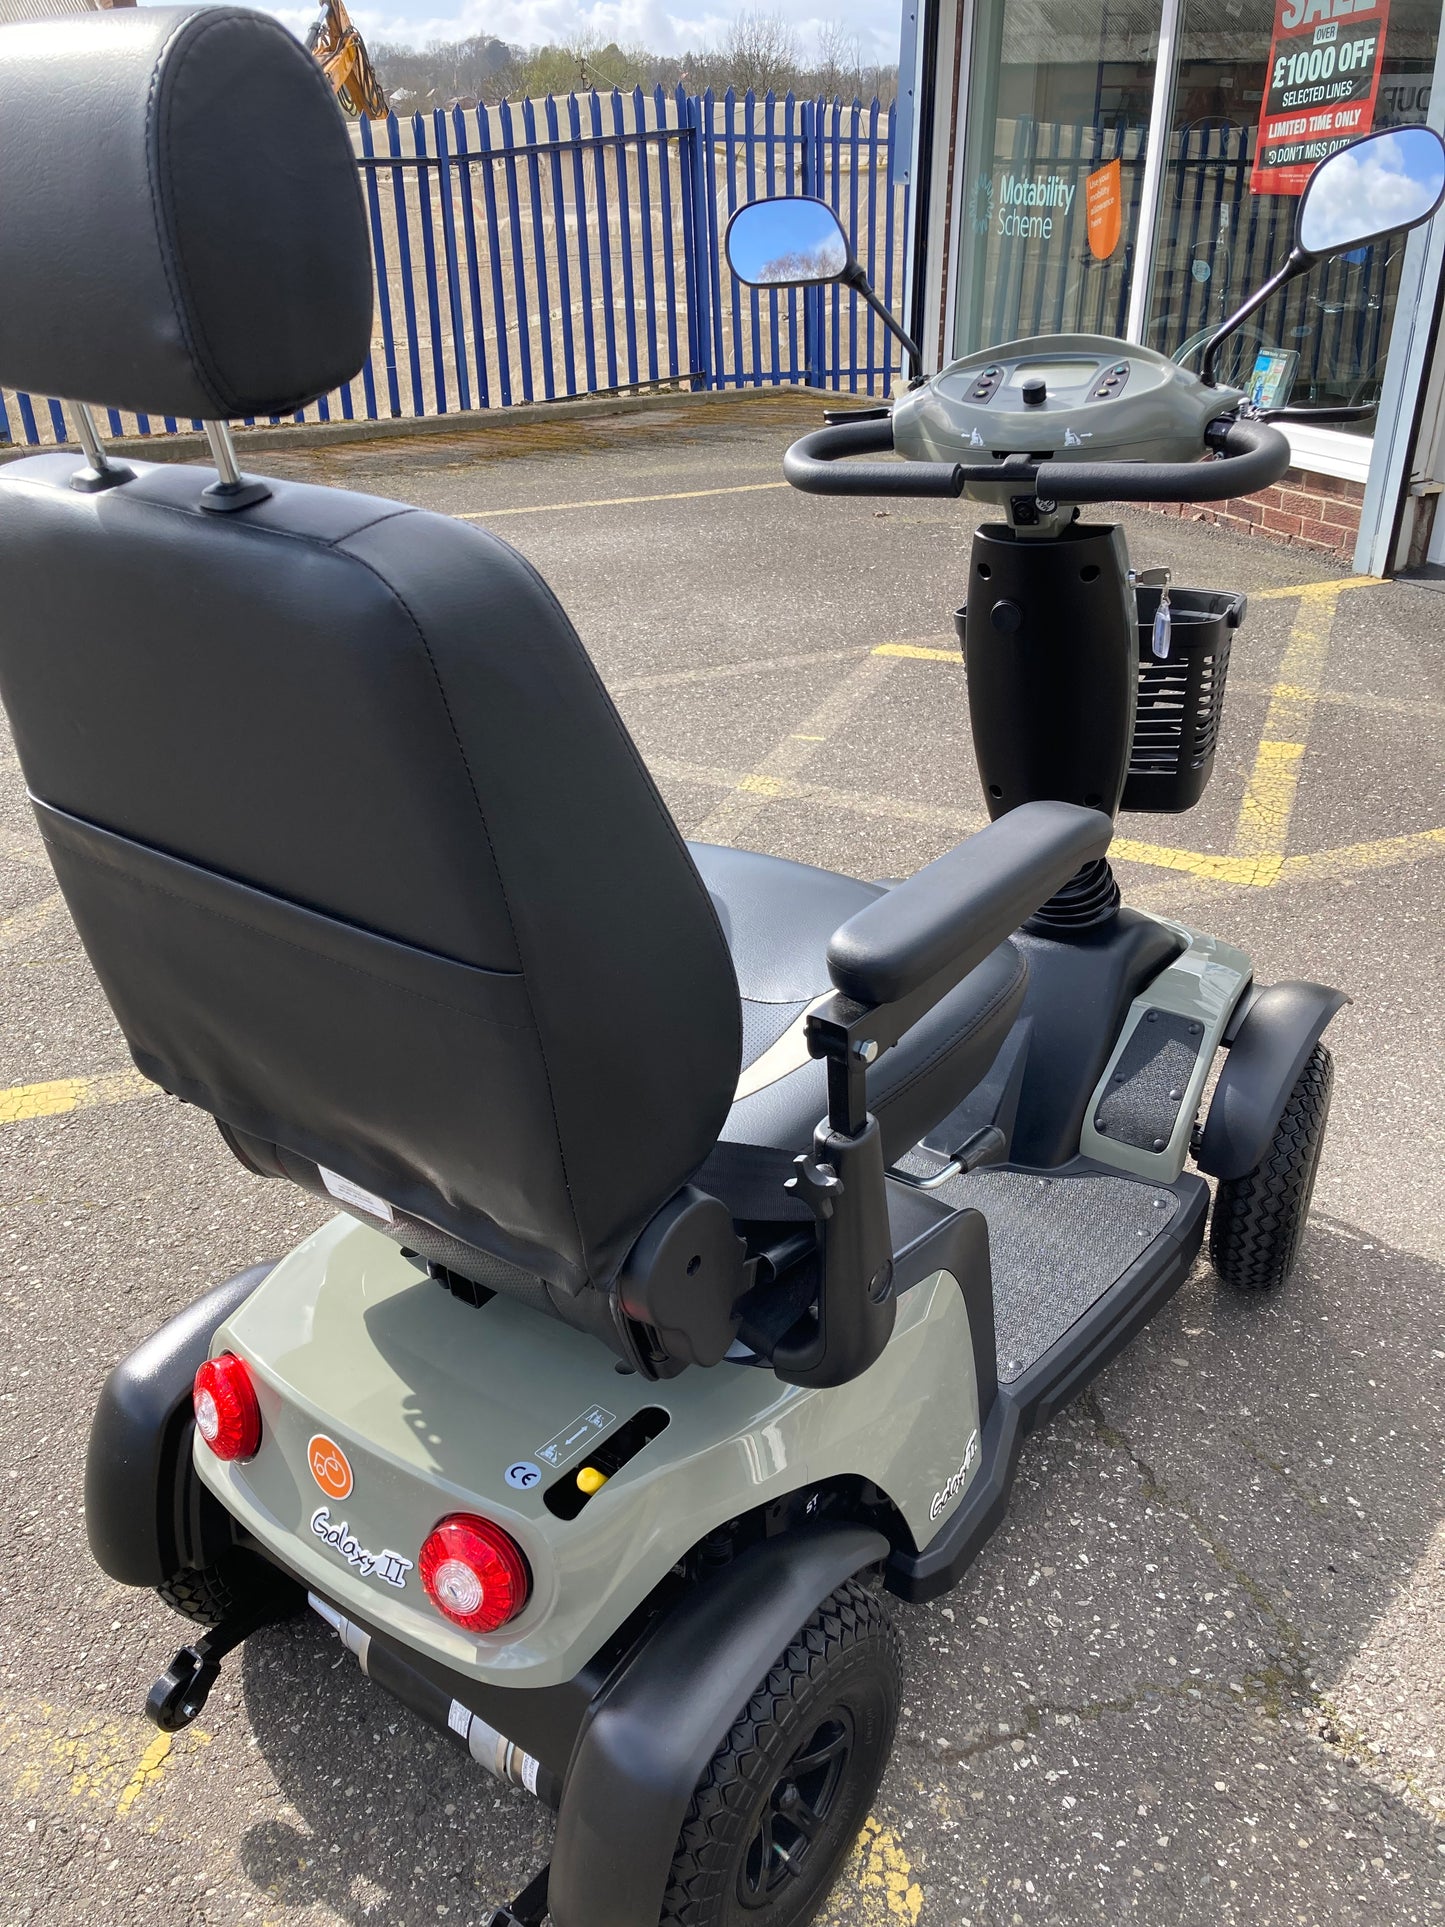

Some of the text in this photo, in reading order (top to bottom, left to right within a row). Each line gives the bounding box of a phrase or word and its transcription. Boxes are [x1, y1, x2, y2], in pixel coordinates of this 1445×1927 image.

[1281, 0, 1377, 29] SA
[1316, 26, 1337, 41] OVER
[1272, 38, 1376, 88] £1000 OFF
[1282, 80, 1353, 107] SELECTED LINES
[1268, 109, 1362, 138] LIMITED TIME ONLY
[1277, 145, 1305, 163] DON'T
[1305, 143, 1328, 159] MISS
[1000, 175, 1075, 215] Motability
[998, 207, 1052, 239] Scheme
[510, 1466, 538, 1486] CE
[311, 1511, 411, 1585] Galaxy II
